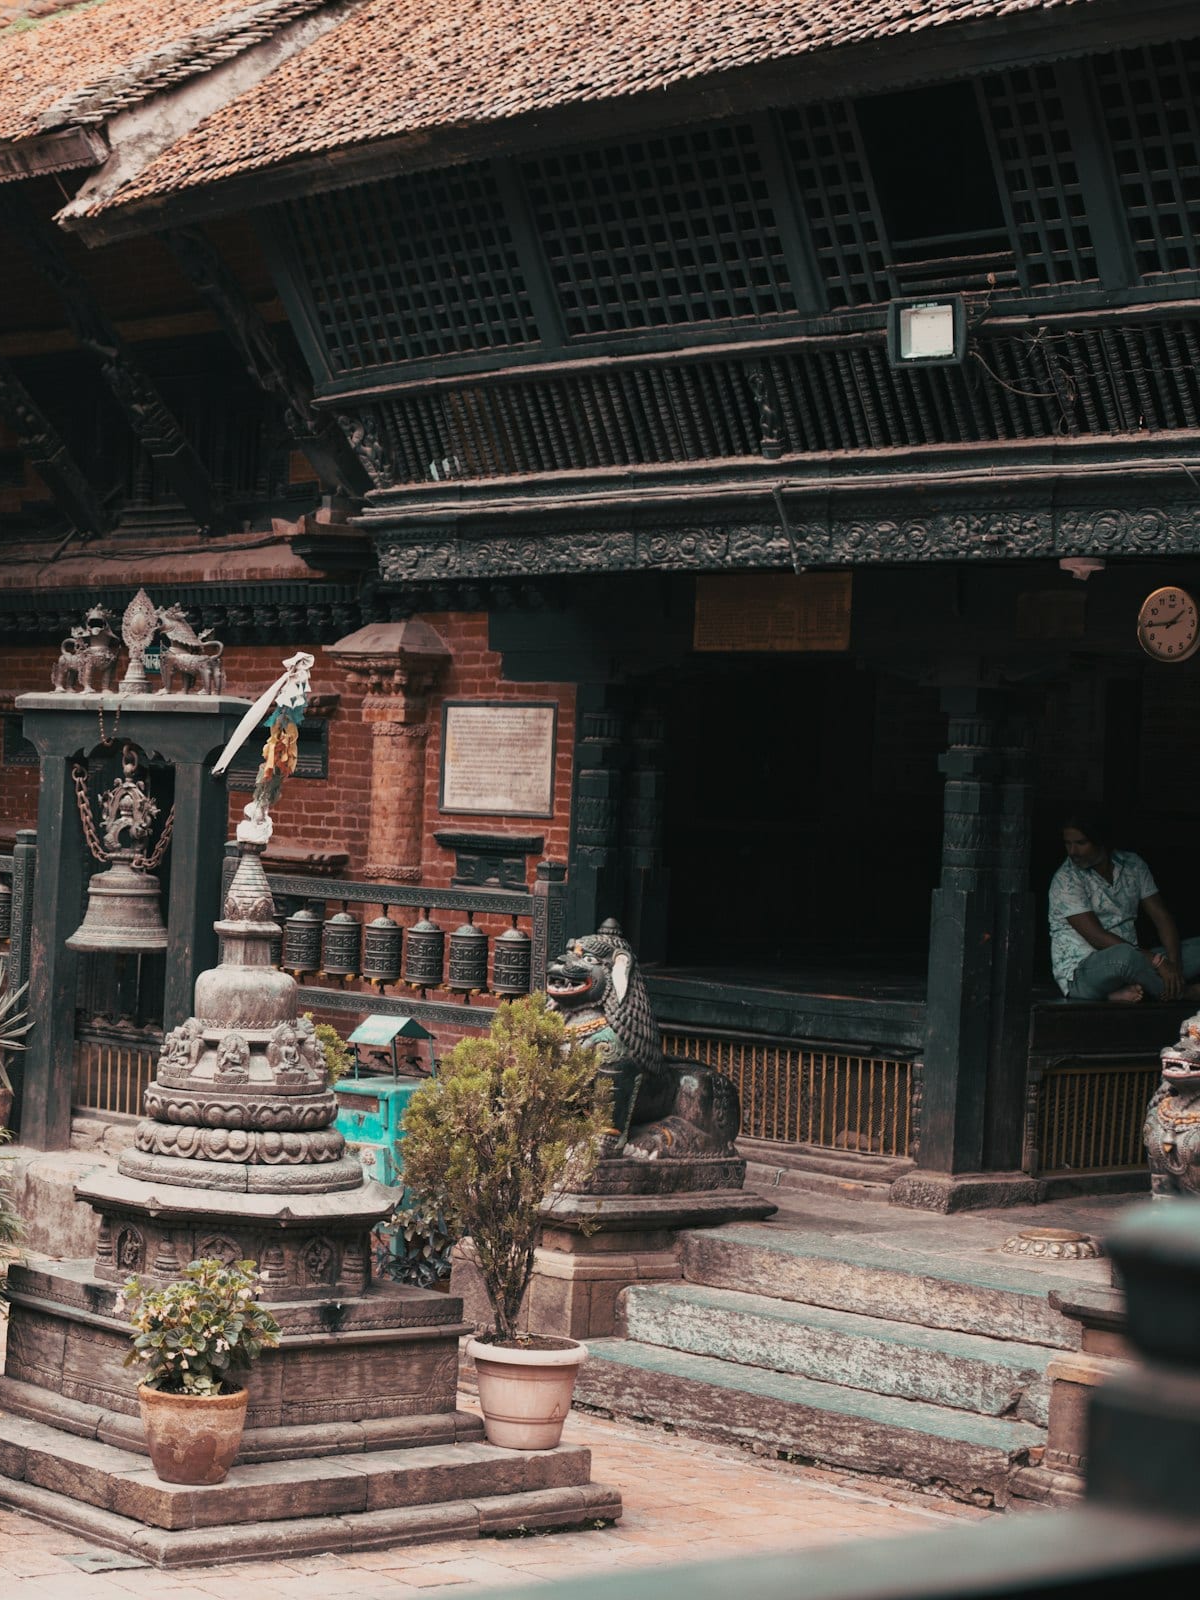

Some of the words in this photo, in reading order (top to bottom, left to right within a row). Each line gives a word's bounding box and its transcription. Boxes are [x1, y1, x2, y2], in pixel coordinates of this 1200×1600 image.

[1159, 598, 1165, 606] 11
[1169, 594, 1176, 602] 12
[1151, 608, 1159, 616] 10
[1188, 606, 1193, 615] 2
[1150, 633, 1155, 641] 8
[1167, 645, 1173, 653] 6
[1178, 642, 1184, 650] 5
